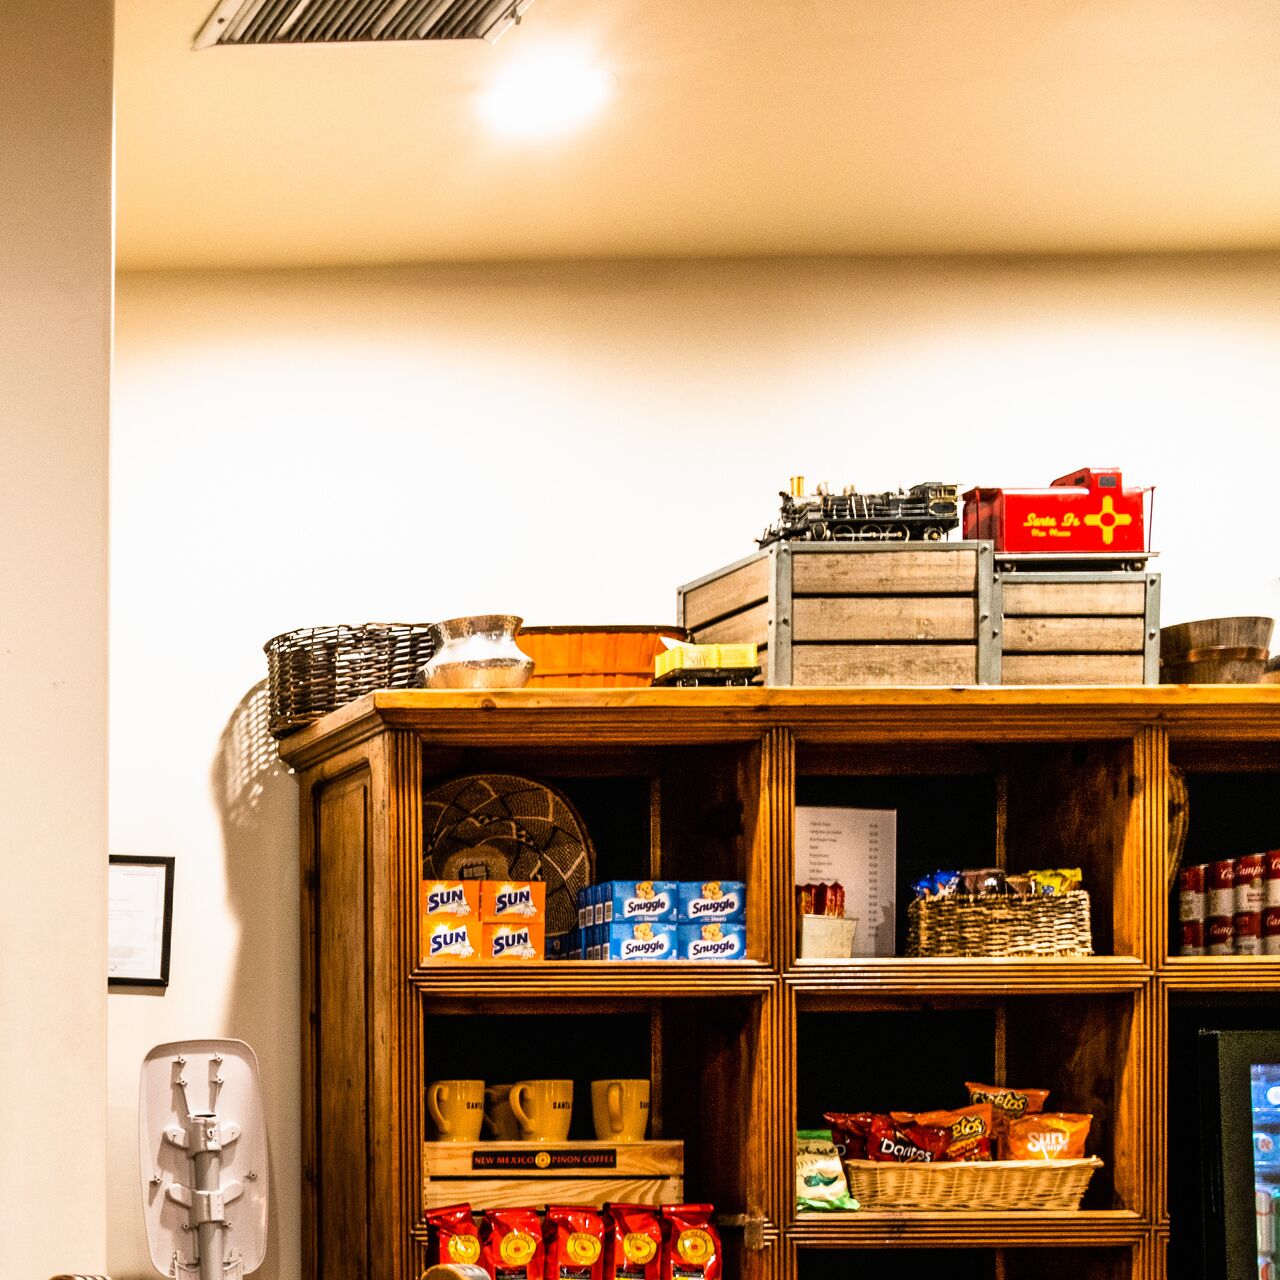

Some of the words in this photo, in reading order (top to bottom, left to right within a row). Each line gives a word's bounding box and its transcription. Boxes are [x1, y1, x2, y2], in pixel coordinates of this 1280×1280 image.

[1023, 512, 1057, 527] Santa
[1061, 512, 1080, 527] Fe
[429, 890, 462, 912] SUN
[496, 891, 529, 913] SUN
[628, 899, 665, 913] Snuggle
[692, 899, 735, 914] Snuggle
[432, 931, 466, 953] SUN
[494, 933, 527, 955] SUN
[625, 941, 664, 954] Snuggle
[693, 941, 734, 955] Snuggle
[881, 1138, 932, 1162] Doritos
[496, 1155, 535, 1165] MEXICO
